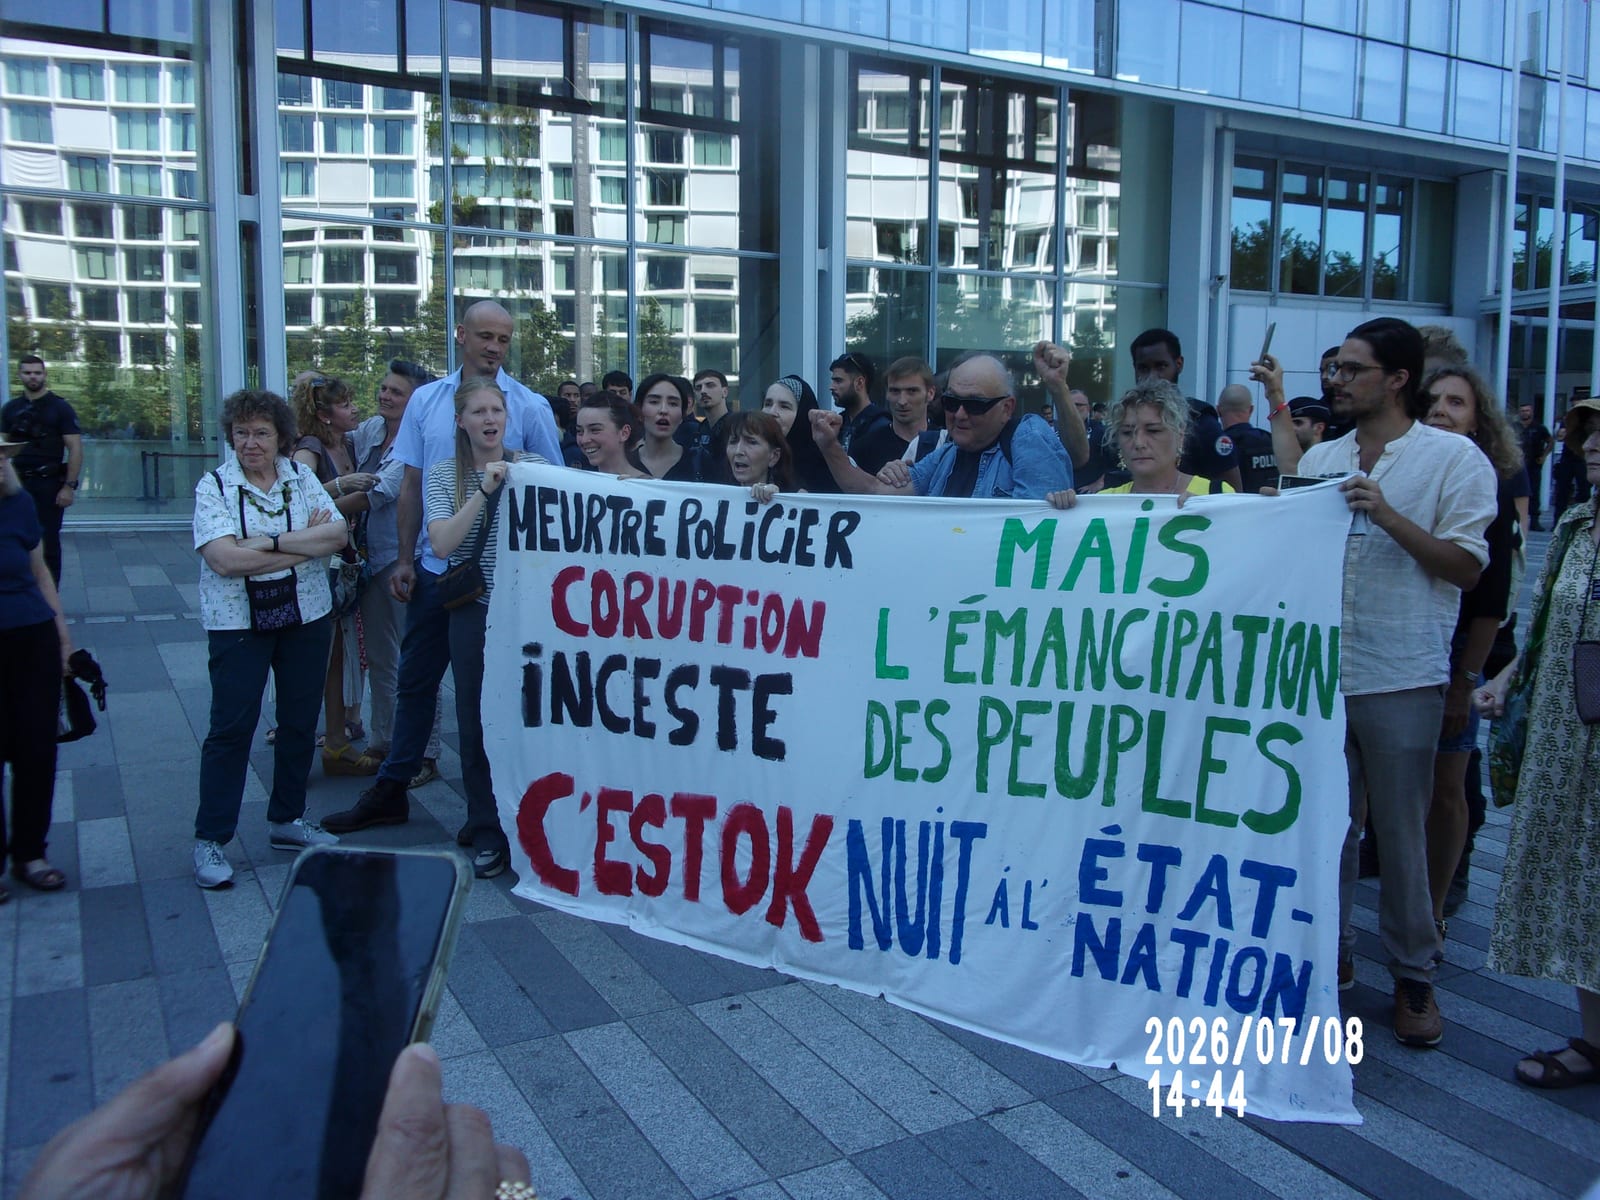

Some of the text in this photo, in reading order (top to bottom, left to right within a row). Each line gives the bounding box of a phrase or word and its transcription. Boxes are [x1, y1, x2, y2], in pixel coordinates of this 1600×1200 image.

[508, 485, 666, 557] MEURTRE
[863, 696, 1303, 835] DES PEUPLES
[1078, 824, 1314, 940] ÉTAT-
[1070, 912, 1314, 1036] NATION
